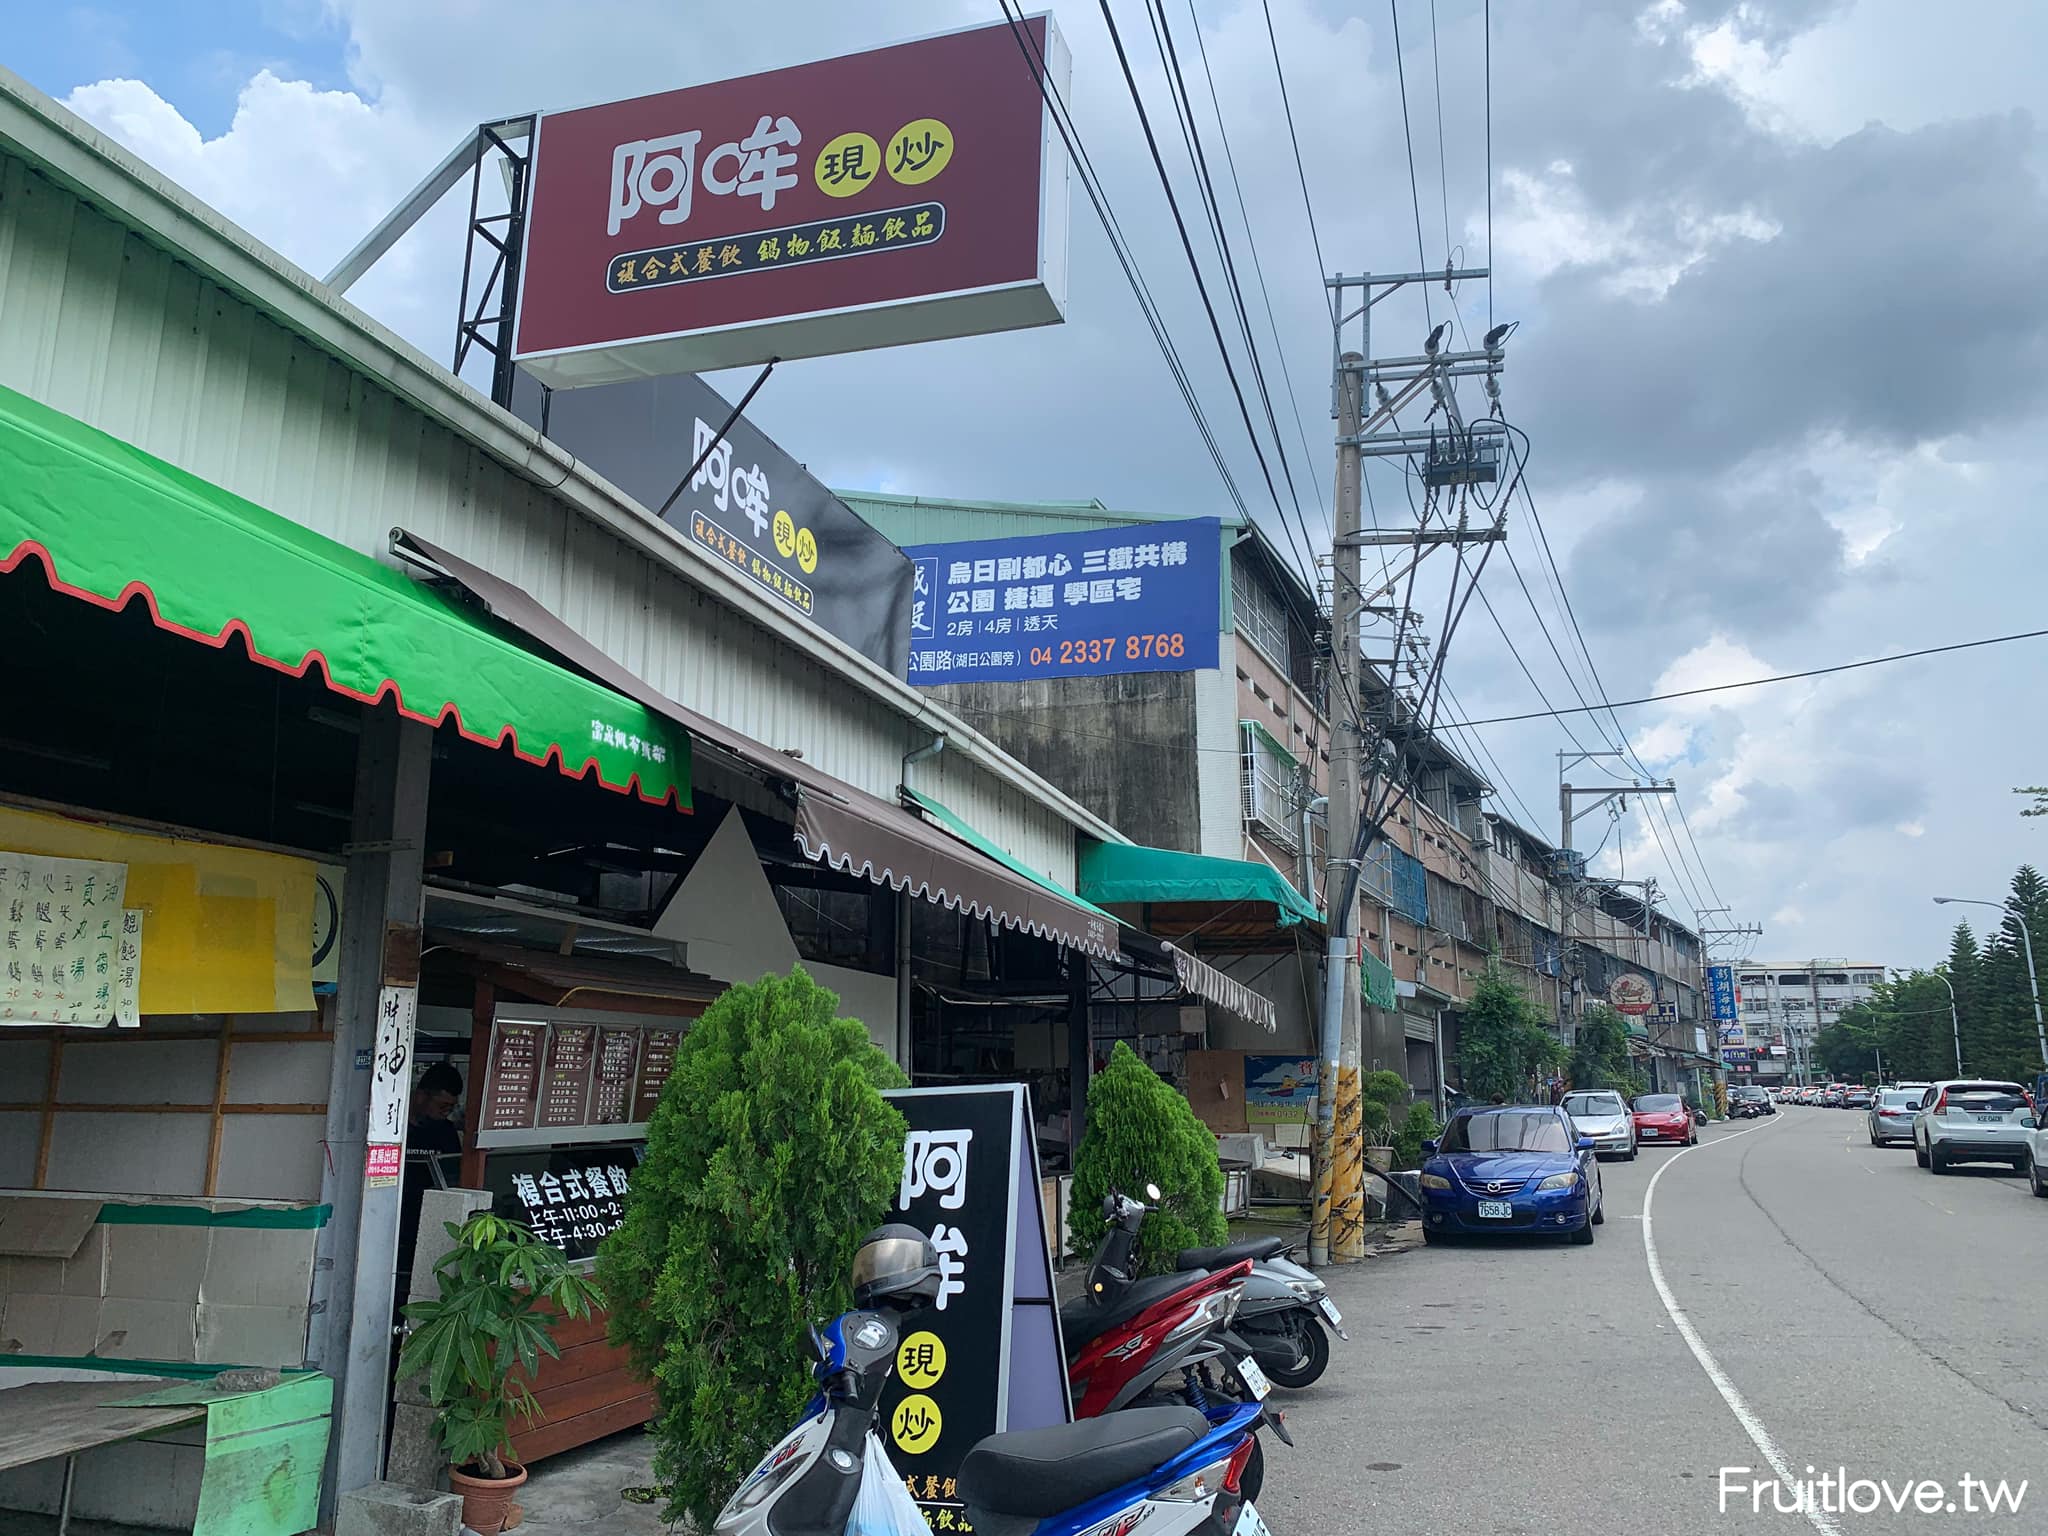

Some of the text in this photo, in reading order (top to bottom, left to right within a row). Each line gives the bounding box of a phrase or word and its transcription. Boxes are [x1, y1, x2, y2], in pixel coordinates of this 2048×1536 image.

[607, 115, 948, 236] 阿哞 現炒
[617, 244, 742, 285] 複合式餐飲
[691, 417, 816, 566] 阿哞 現炒
[695, 518, 747, 567] 複合式餐飲
[948, 541, 1188, 585] 烏日副都心 三鐵共構
[947, 589, 995, 614] 公園
[1004, 584, 1055, 611] 捷運
[1063, 577, 1142, 606] 學區宅
[1023, 614, 1059, 632] 透天
[1030, 633, 1185, 666] 04 2337 8768
[1715, 968, 1733, 1018] 澎湖海鮮
[512, 1165, 632, 1207] 複合式餐飲
[895, 1340, 941, 1444] 現炒
